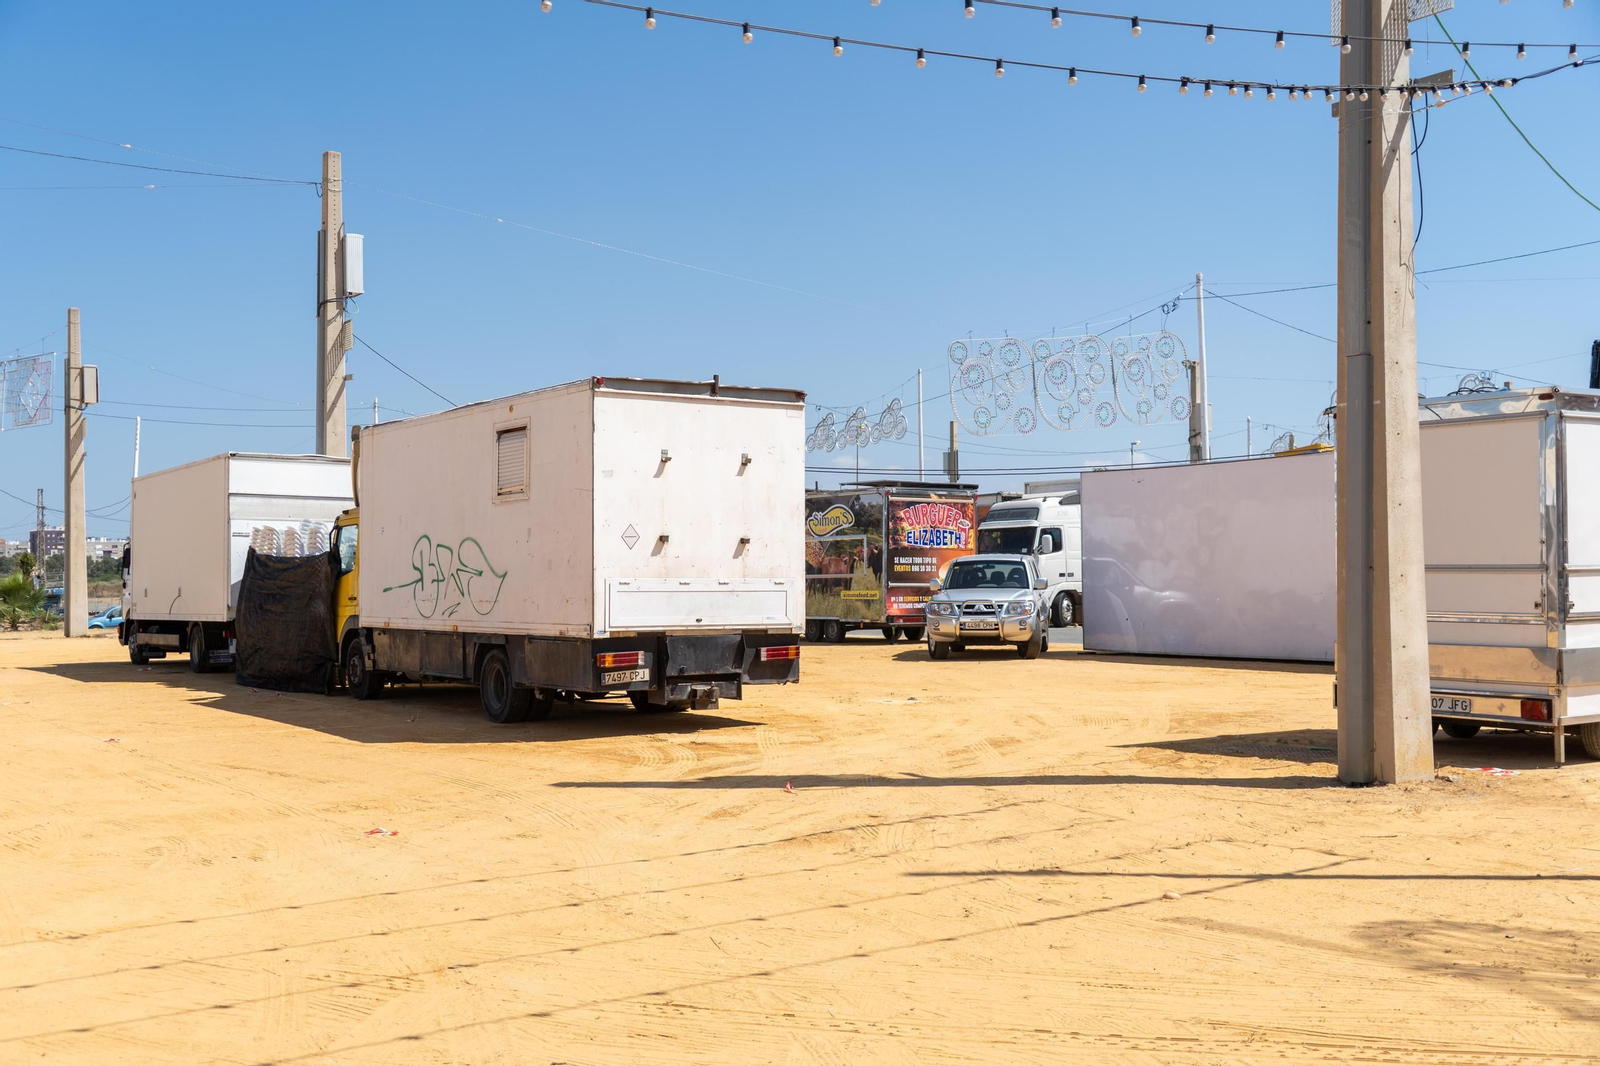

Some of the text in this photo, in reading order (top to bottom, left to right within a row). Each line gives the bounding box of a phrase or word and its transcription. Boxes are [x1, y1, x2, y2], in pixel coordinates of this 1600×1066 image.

[902, 503, 963, 527] BURGUER
[906, 528, 962, 547] ELIZABETH
[606, 670, 646, 684] 7497 CPJ
[1448, 698, 1468, 711] JFG
